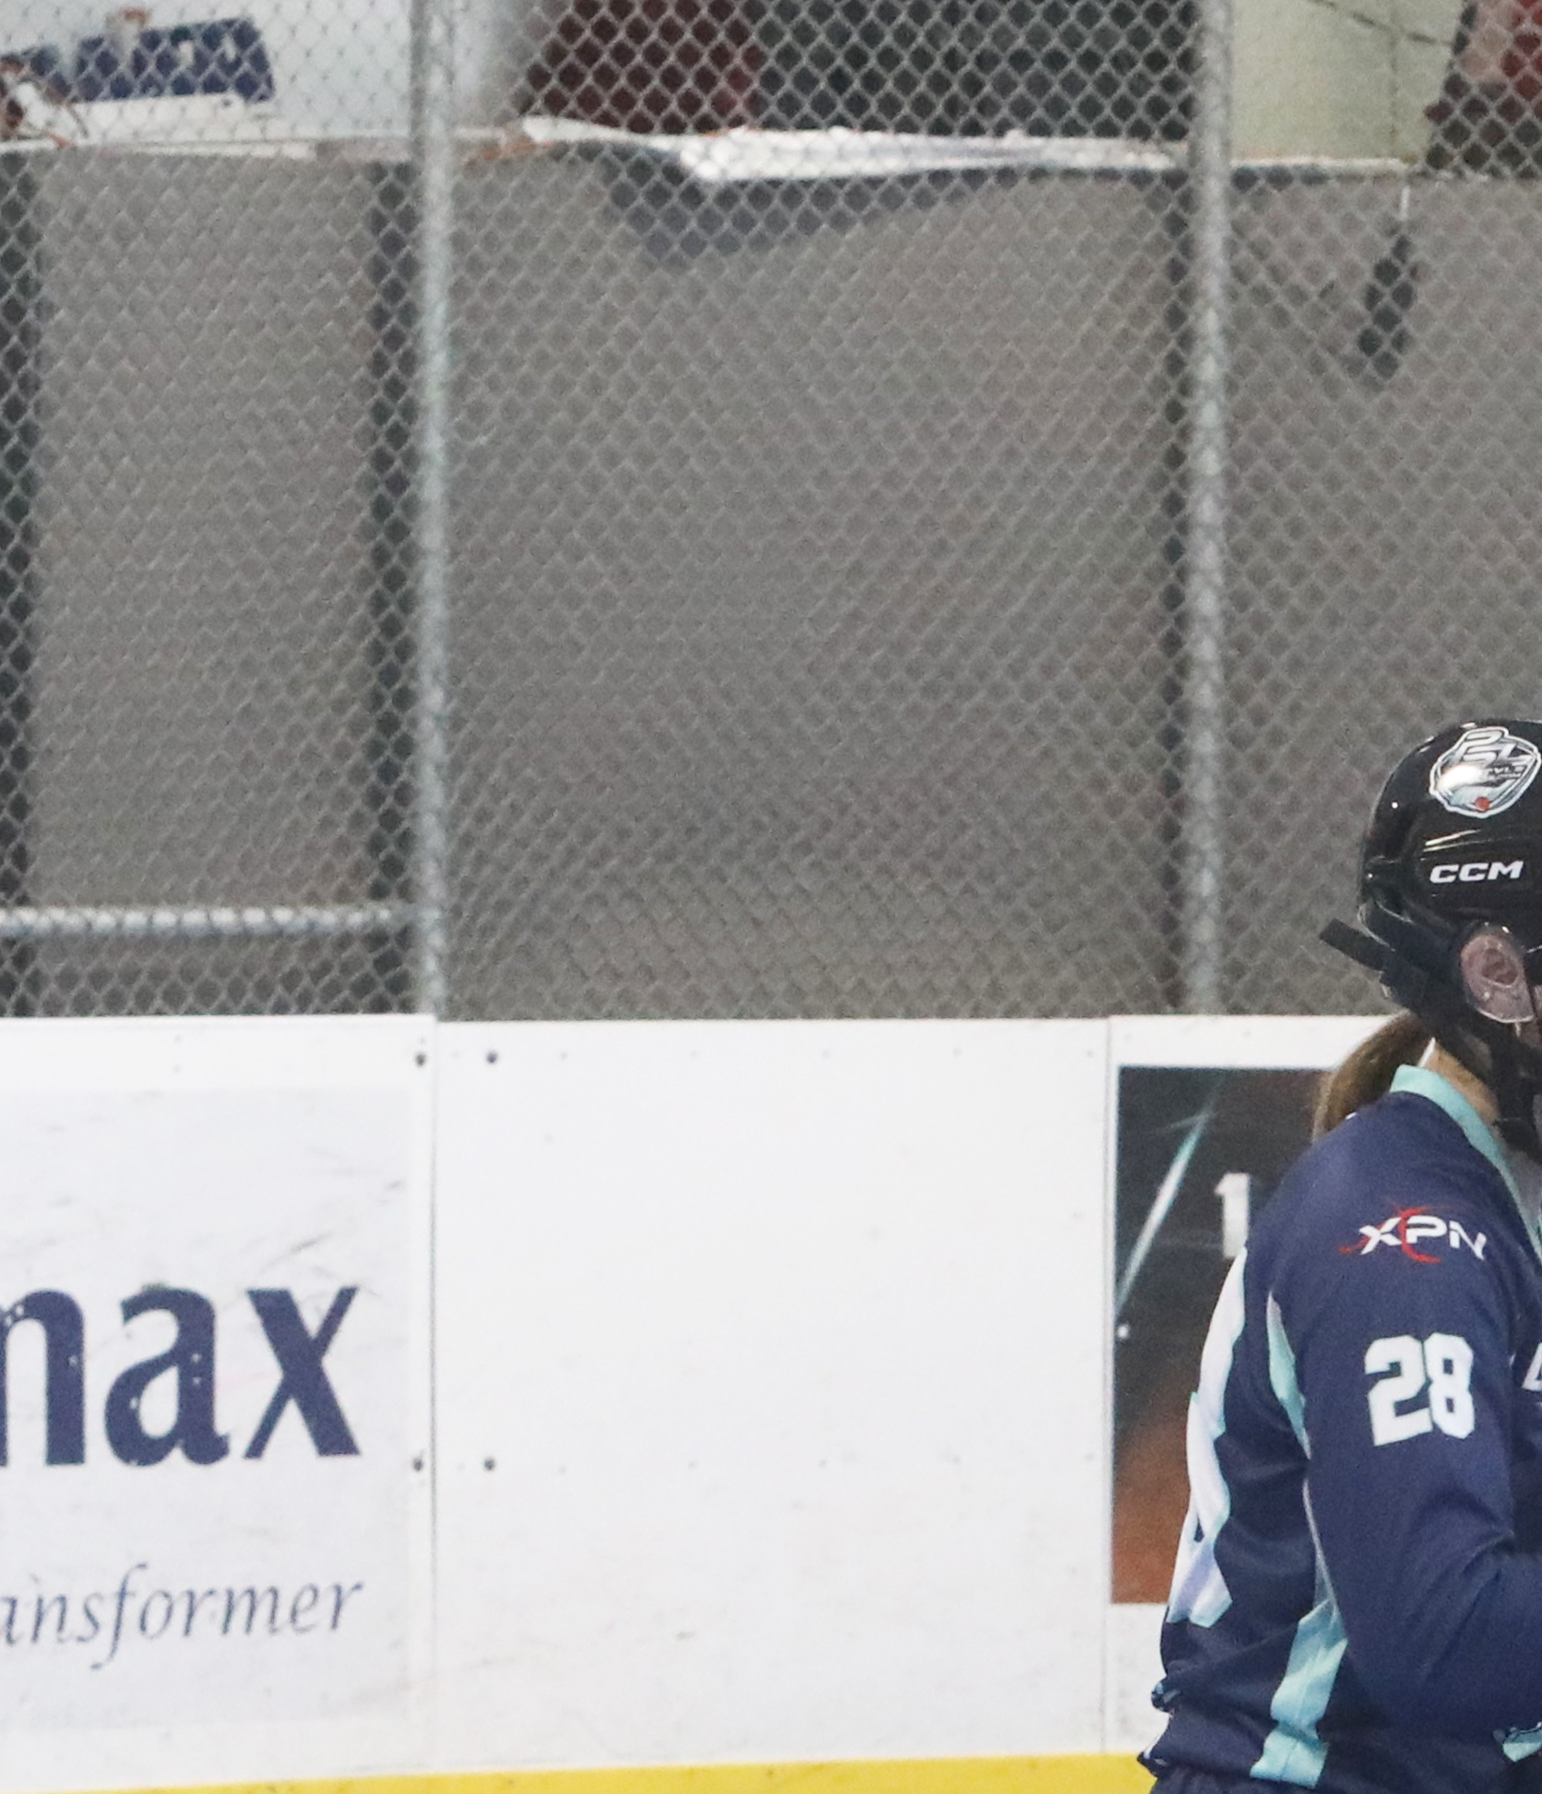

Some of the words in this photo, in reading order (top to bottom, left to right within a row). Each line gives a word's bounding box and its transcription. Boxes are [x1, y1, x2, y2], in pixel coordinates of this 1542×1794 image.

[1429, 860, 1524, 884] CCM
[1358, 1214, 1488, 1261] XPN
[1364, 1332, 1475, 1446] 28
